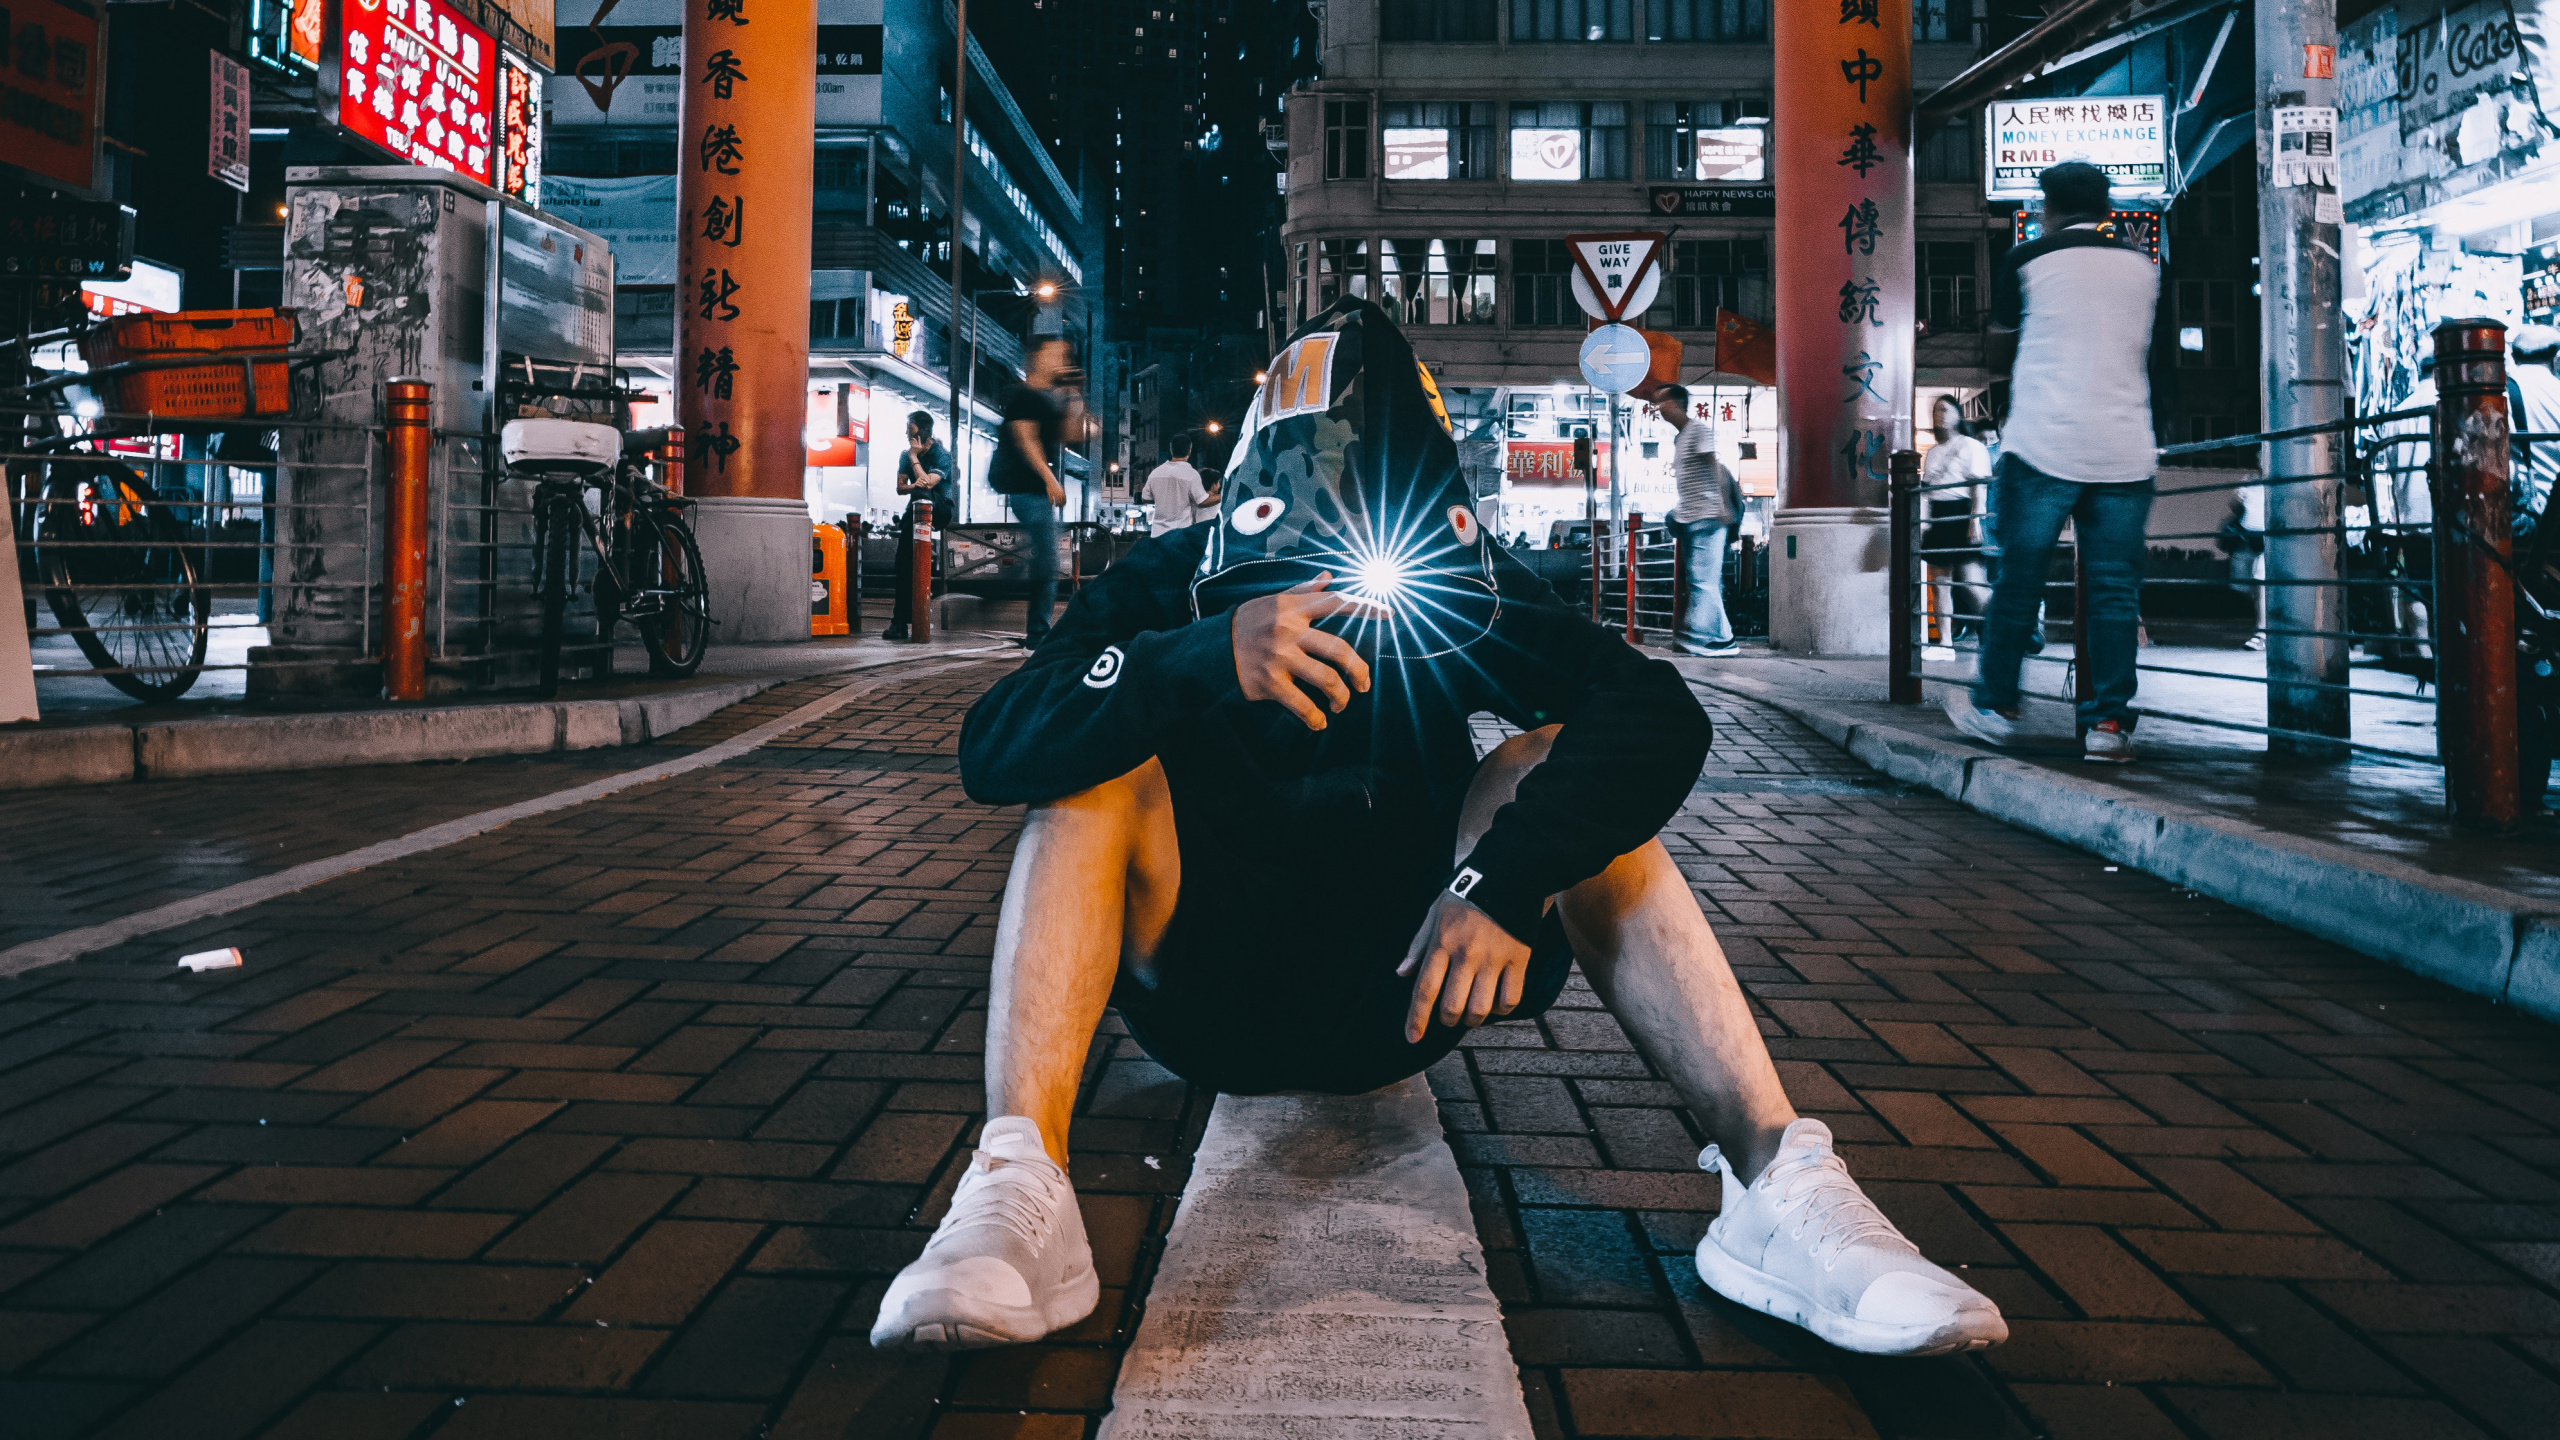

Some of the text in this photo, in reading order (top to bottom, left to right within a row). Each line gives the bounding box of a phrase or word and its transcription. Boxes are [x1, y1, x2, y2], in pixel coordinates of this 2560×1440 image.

[2002, 126, 2158, 144] MONEY EXCHANGE
[2002, 149, 2056, 163] RMB
[1998, 167, 2042, 179] WEST
[2100, 164, 2131, 176] ION
[1684, 190, 1720, 198] HAPPY
[1721, 190, 1755, 199] NEWS
[1598, 244, 1631, 254] GIVE
[1600, 257, 1630, 268] WAY
[1653, 484, 1674, 496] KEE
